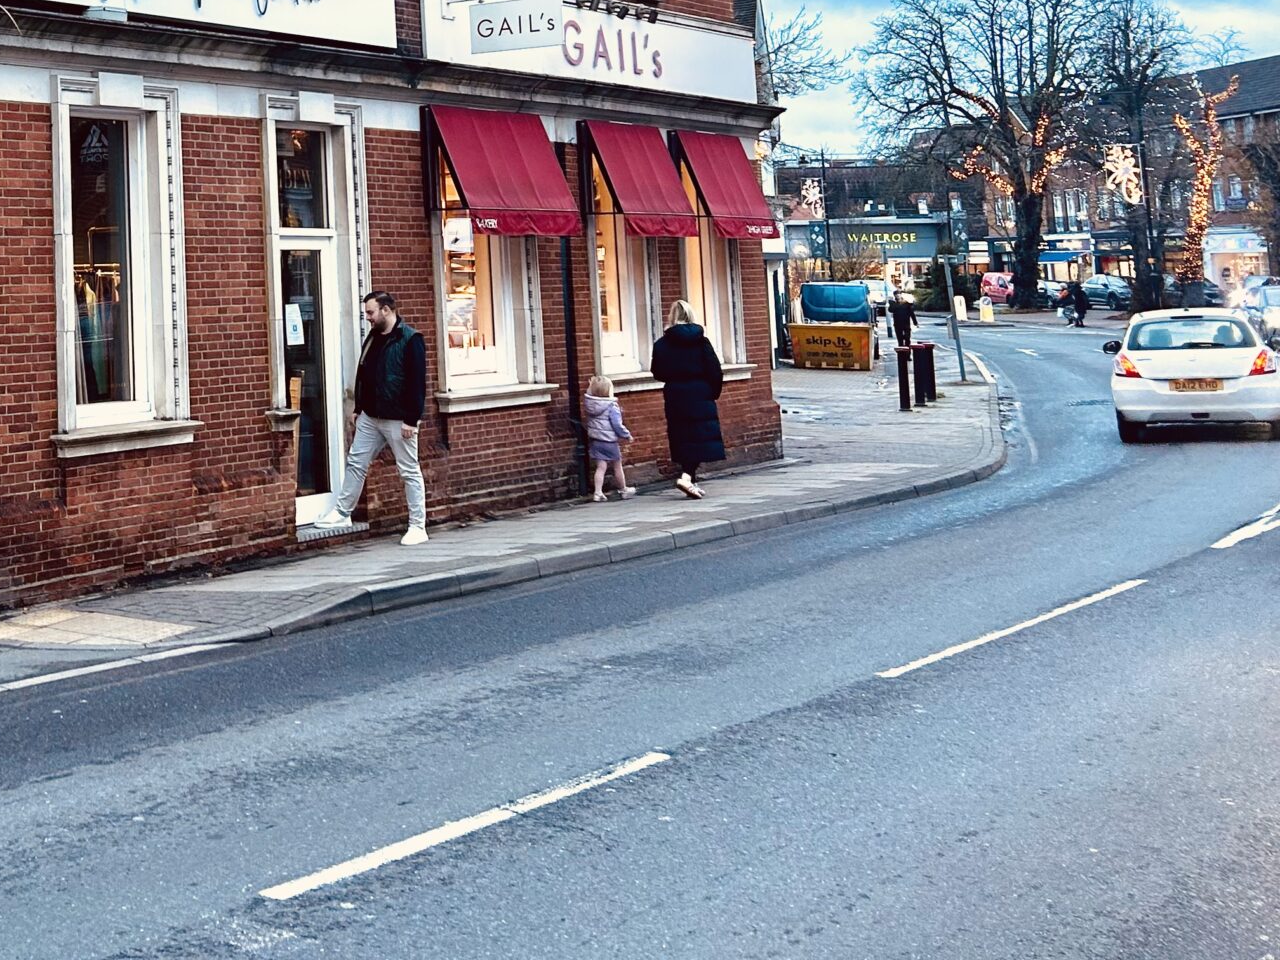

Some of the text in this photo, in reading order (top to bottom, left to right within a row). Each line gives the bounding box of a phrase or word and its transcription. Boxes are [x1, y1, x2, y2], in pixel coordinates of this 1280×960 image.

[477, 12, 555, 38] GAIL's
[562, 20, 663, 78] GAIL's
[847, 233, 917, 243] WAITROSE
[805, 335, 832, 348] skip
